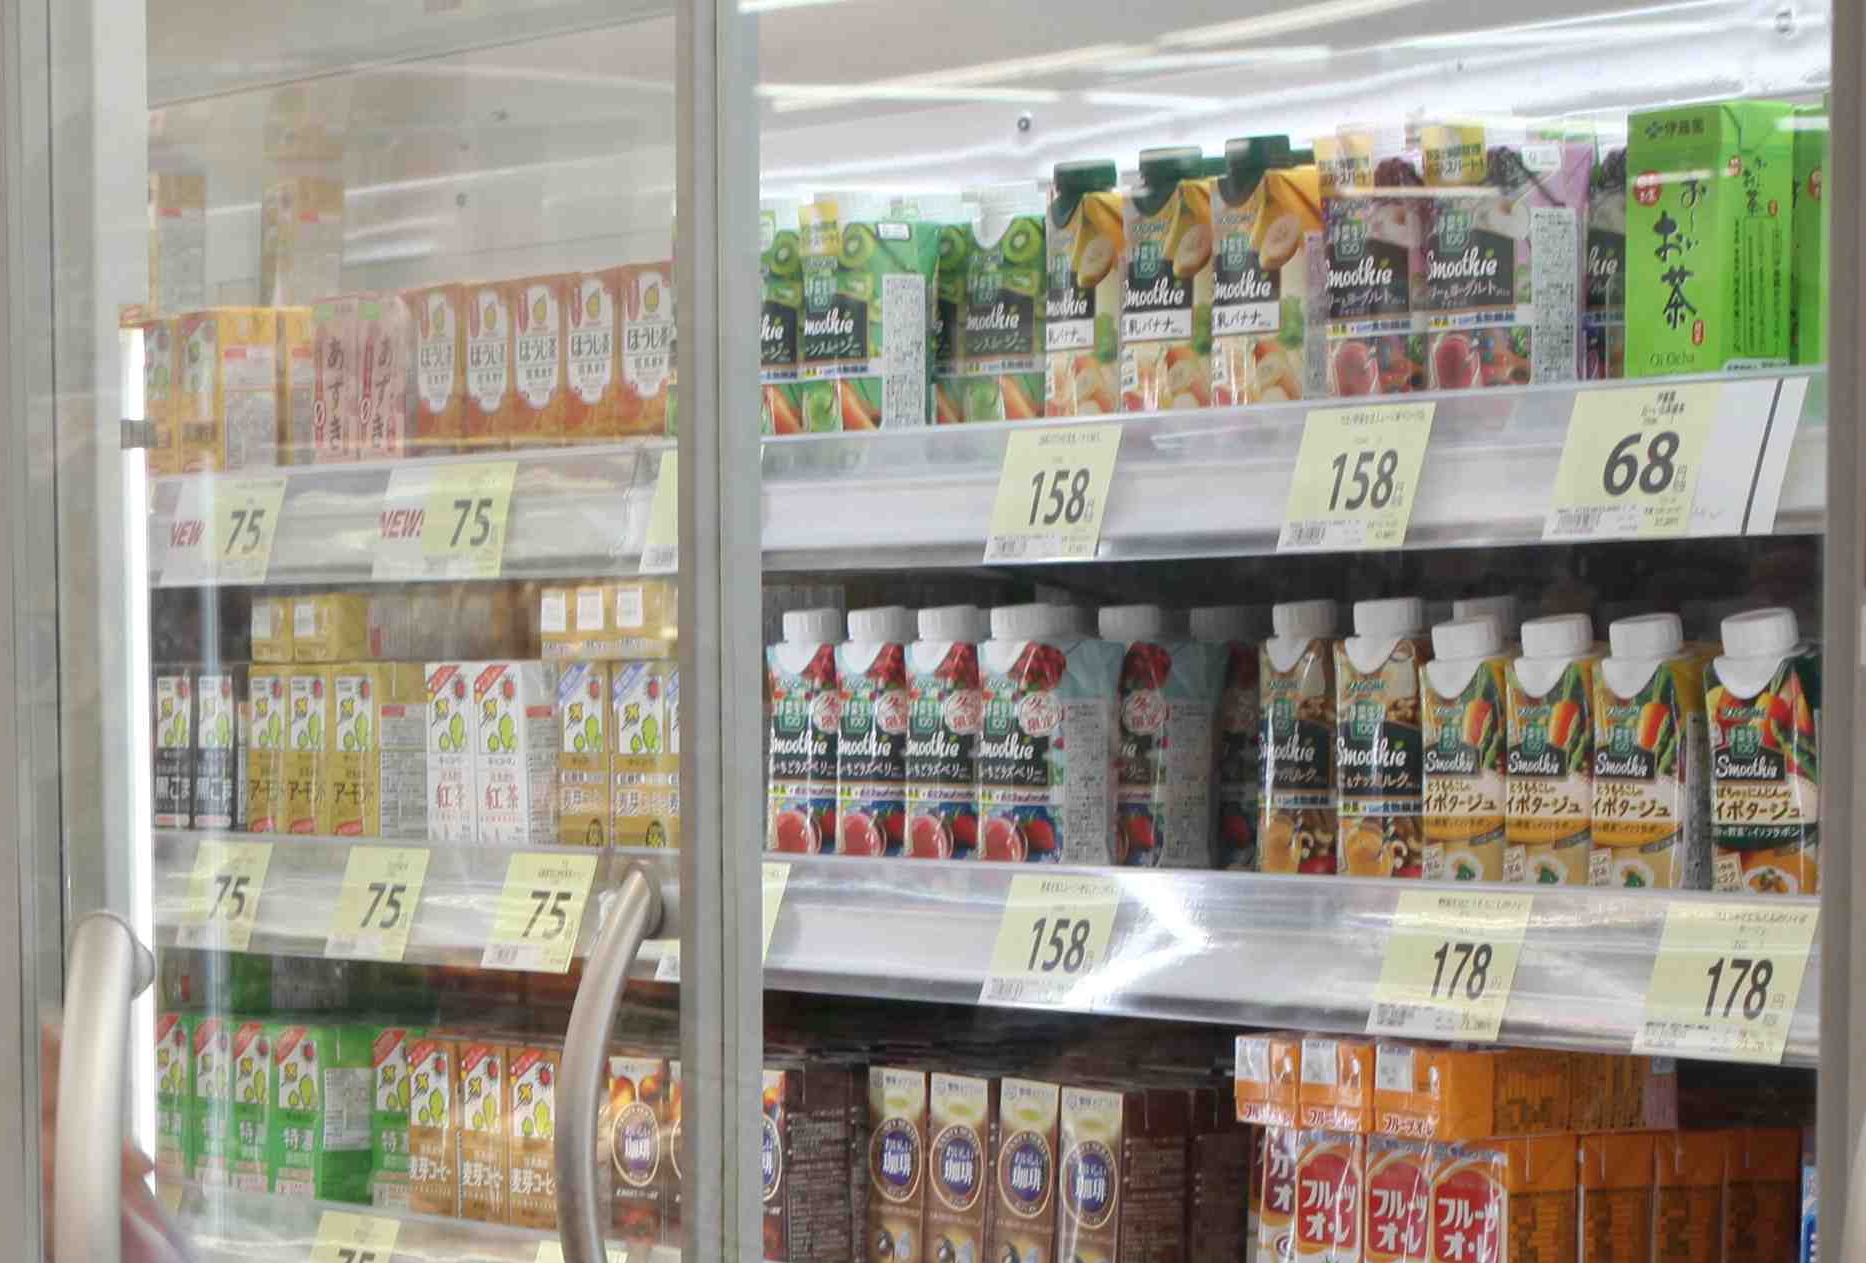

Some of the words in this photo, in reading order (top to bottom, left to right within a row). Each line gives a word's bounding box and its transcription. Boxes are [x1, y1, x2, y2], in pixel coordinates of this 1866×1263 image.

[1329, 449, 1398, 512] 158
[1604, 431, 1680, 496] 68
[1029, 468, 1090, 526] 158
[224, 510, 265, 554] 75
[449, 499, 492, 547] 75
[486, 784, 518, 810] 紅茶
[209, 876, 250, 920] 75
[360, 882, 405, 929] 75
[521, 890, 571, 939] 75
[1026, 915, 1089, 974] 158
[1431, 942, 1493, 1001] 178
[1704, 958, 1773, 1019] 178
[1301, 1179, 1357, 1210] フルーツ
[1372, 1188, 1427, 1223] フルーツ
[1438, 1198, 1499, 1234] フルーツ
